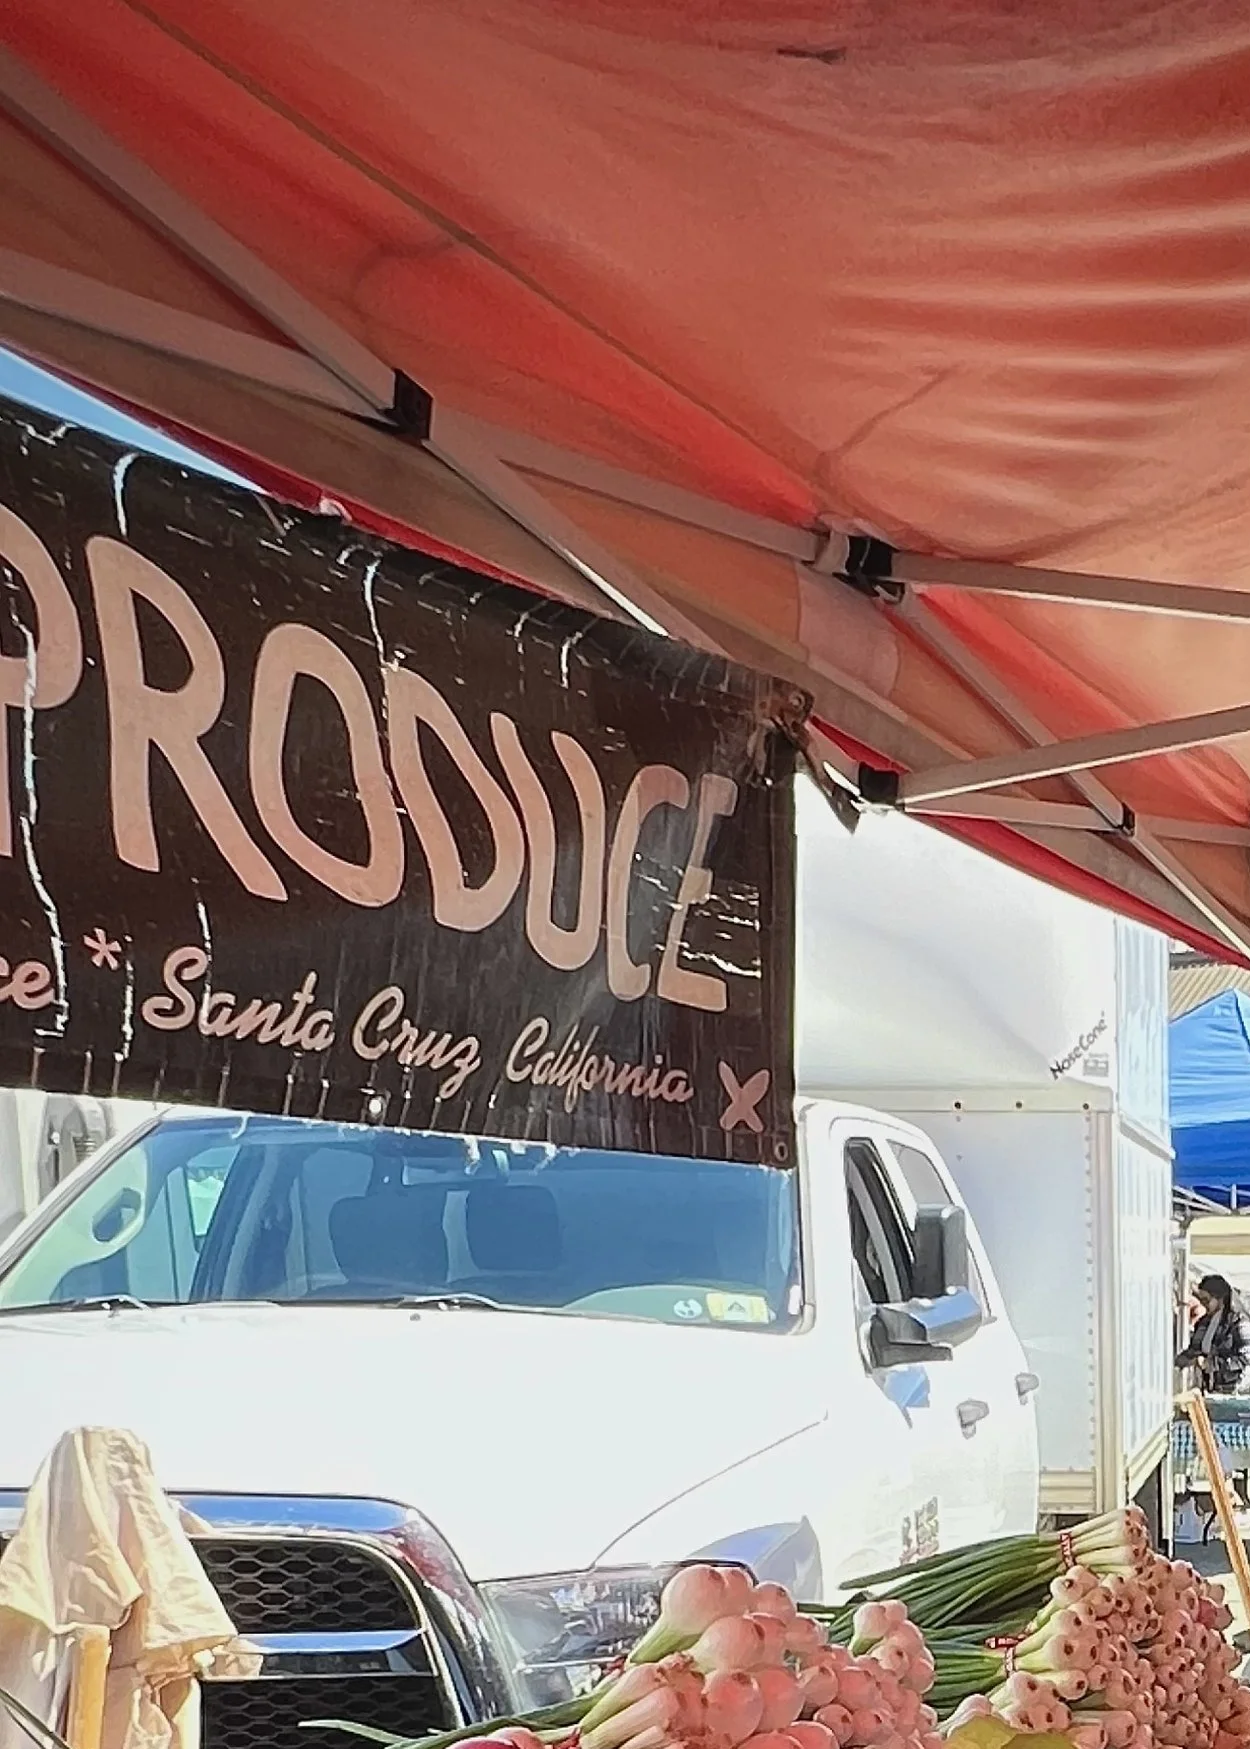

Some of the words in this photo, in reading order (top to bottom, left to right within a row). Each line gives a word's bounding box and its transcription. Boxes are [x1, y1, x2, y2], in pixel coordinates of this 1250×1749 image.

[0, 503, 738, 1012] PRODUCE
[141, 946, 335, 1051] Santa
[352, 985, 480, 1099] Cruz
[507, 1017, 695, 1114] California
[1049, 1018, 1108, 1081] NoseCone
